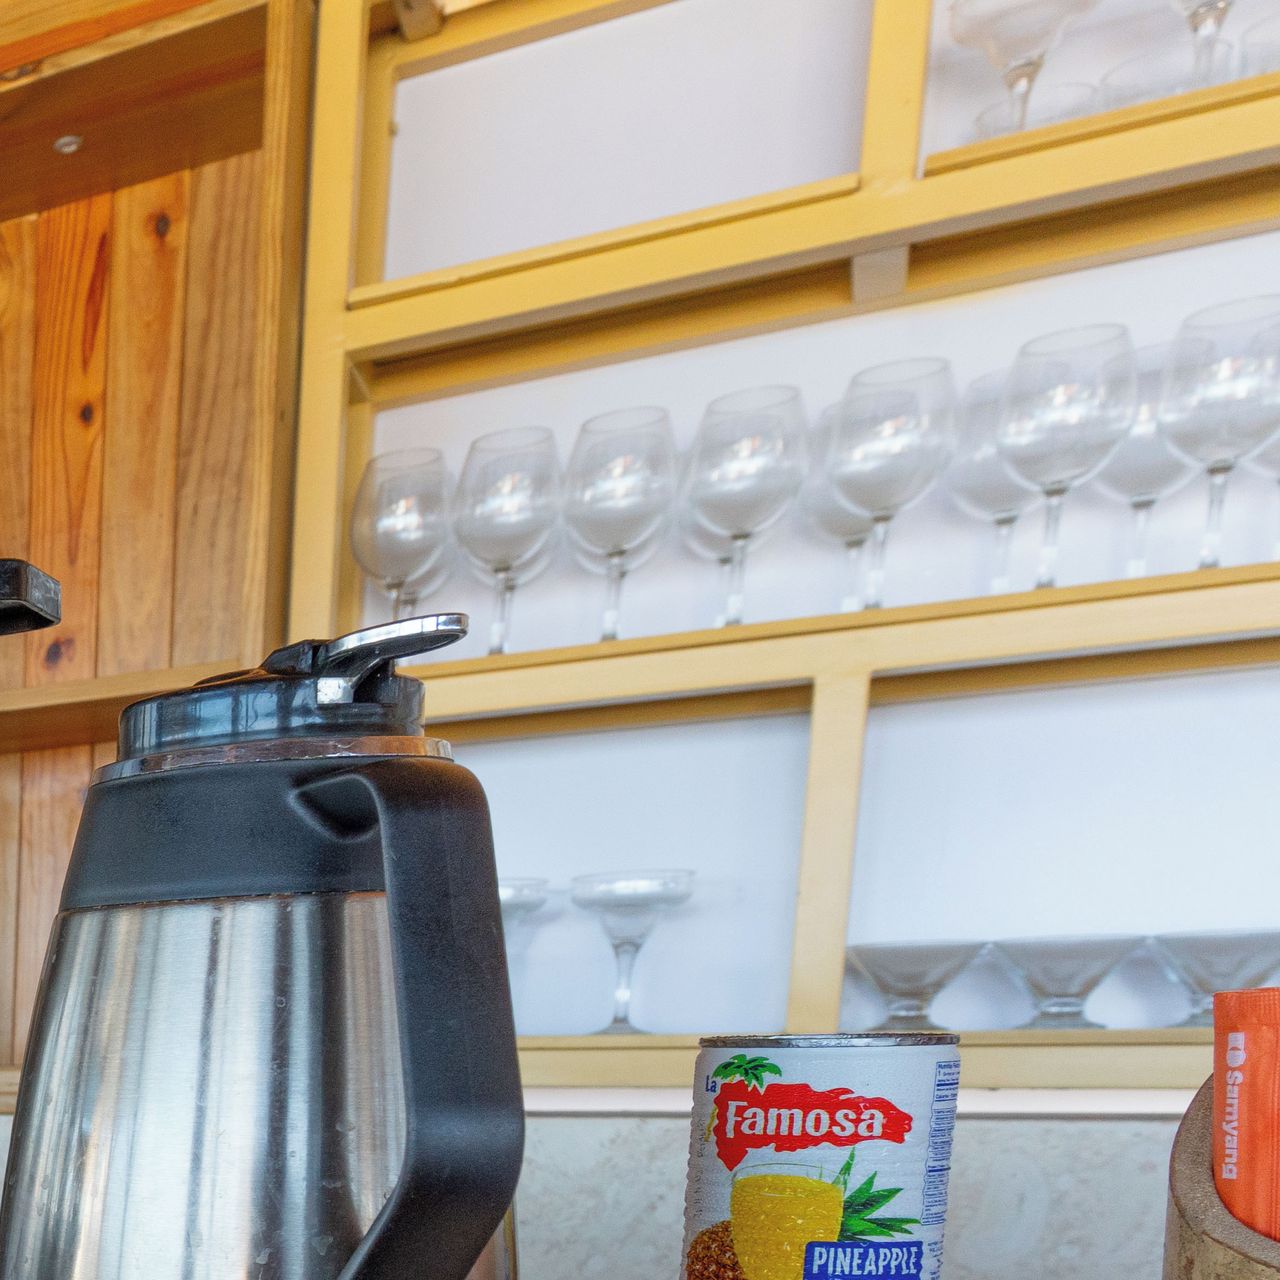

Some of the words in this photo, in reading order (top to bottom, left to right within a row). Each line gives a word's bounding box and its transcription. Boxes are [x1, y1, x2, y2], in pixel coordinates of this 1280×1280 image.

[705, 1075, 717, 1093] La
[725, 1100, 885, 1138] Famosa
[1222, 1070, 1243, 1180] Samyang
[812, 1246, 918, 1275] PINEAPPLE
